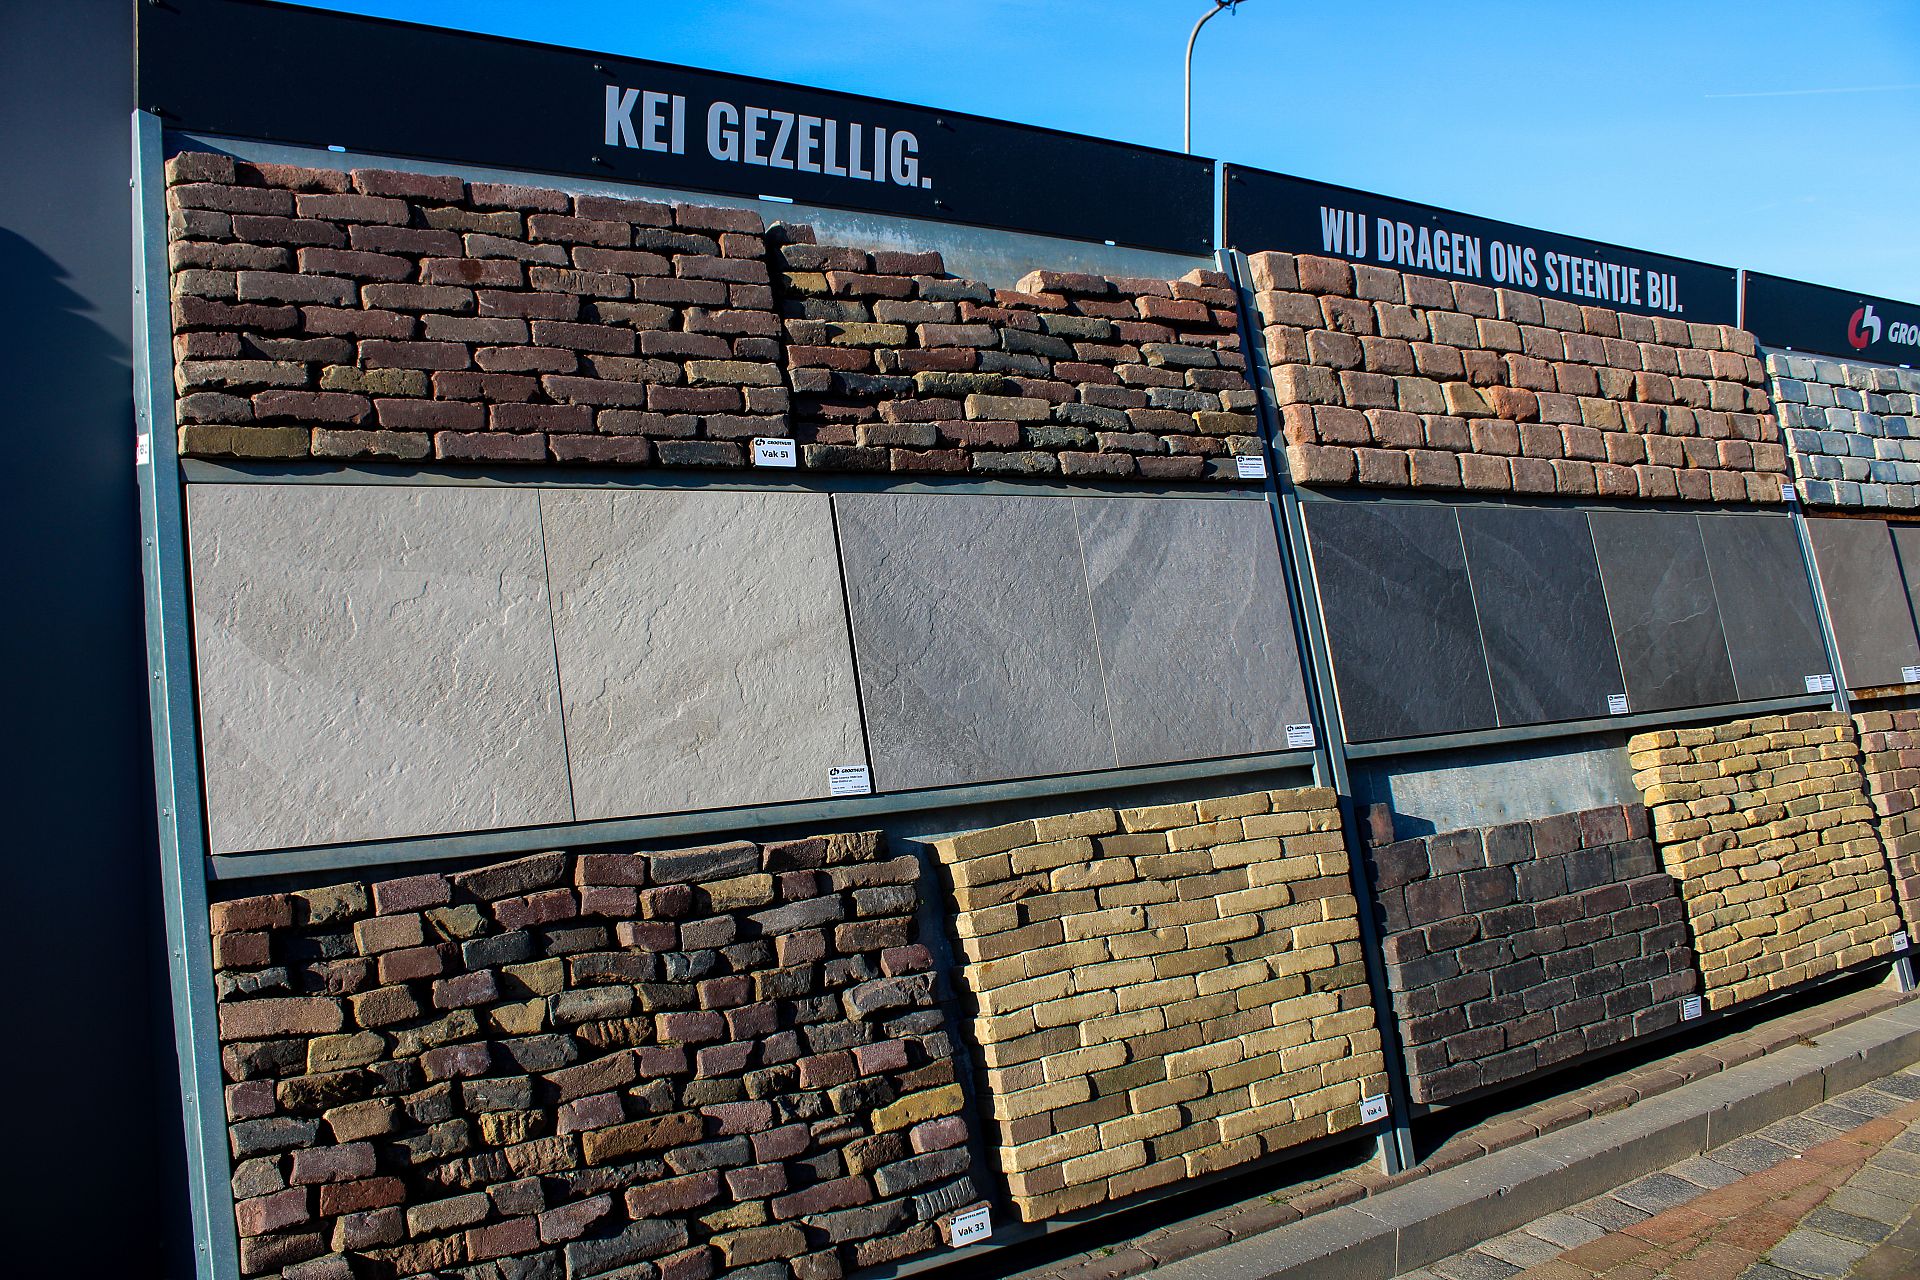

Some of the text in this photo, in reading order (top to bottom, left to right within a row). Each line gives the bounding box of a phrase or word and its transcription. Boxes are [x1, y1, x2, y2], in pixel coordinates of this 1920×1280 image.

[605, 84, 932, 189] KEI GEZELLIG.
[1320, 206, 1683, 313] WIJ DRAGEN ONS STEENTJE BIJ.
[1888, 321, 1920, 348] GRO
[762, 449, 789, 458] Vak 51
[958, 1222, 985, 1237] Vak 33
